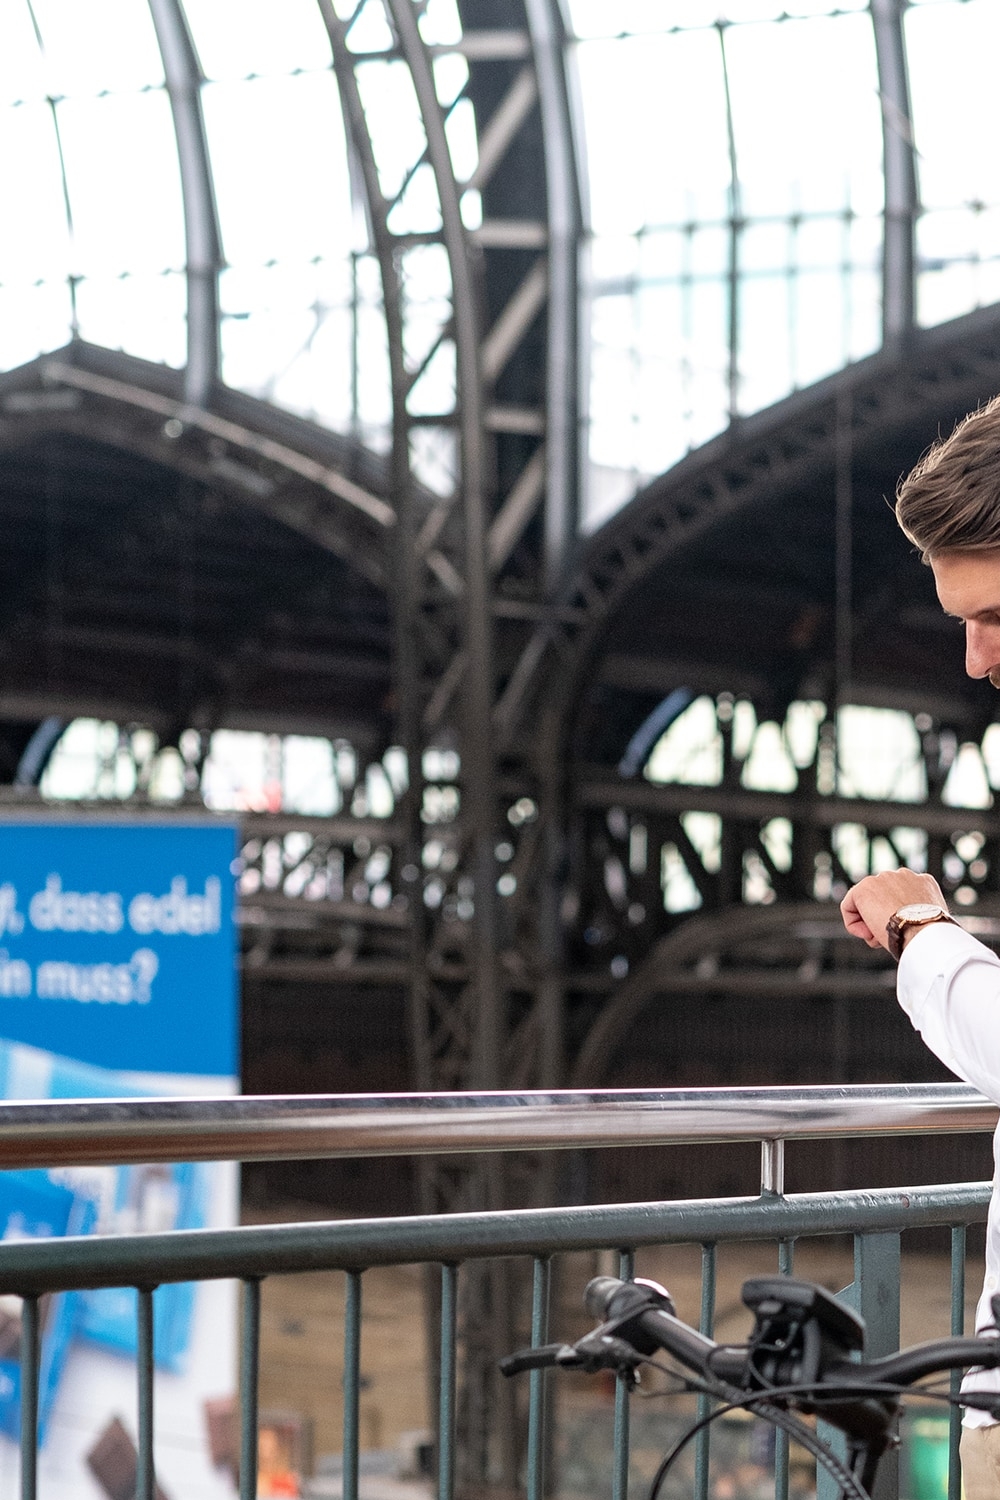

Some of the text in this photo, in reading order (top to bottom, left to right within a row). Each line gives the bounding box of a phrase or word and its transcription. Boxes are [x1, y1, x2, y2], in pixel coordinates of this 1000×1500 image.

[29, 872, 124, 932] dass
[128, 874, 221, 935] edel
[37, 948, 158, 1004] muss?
